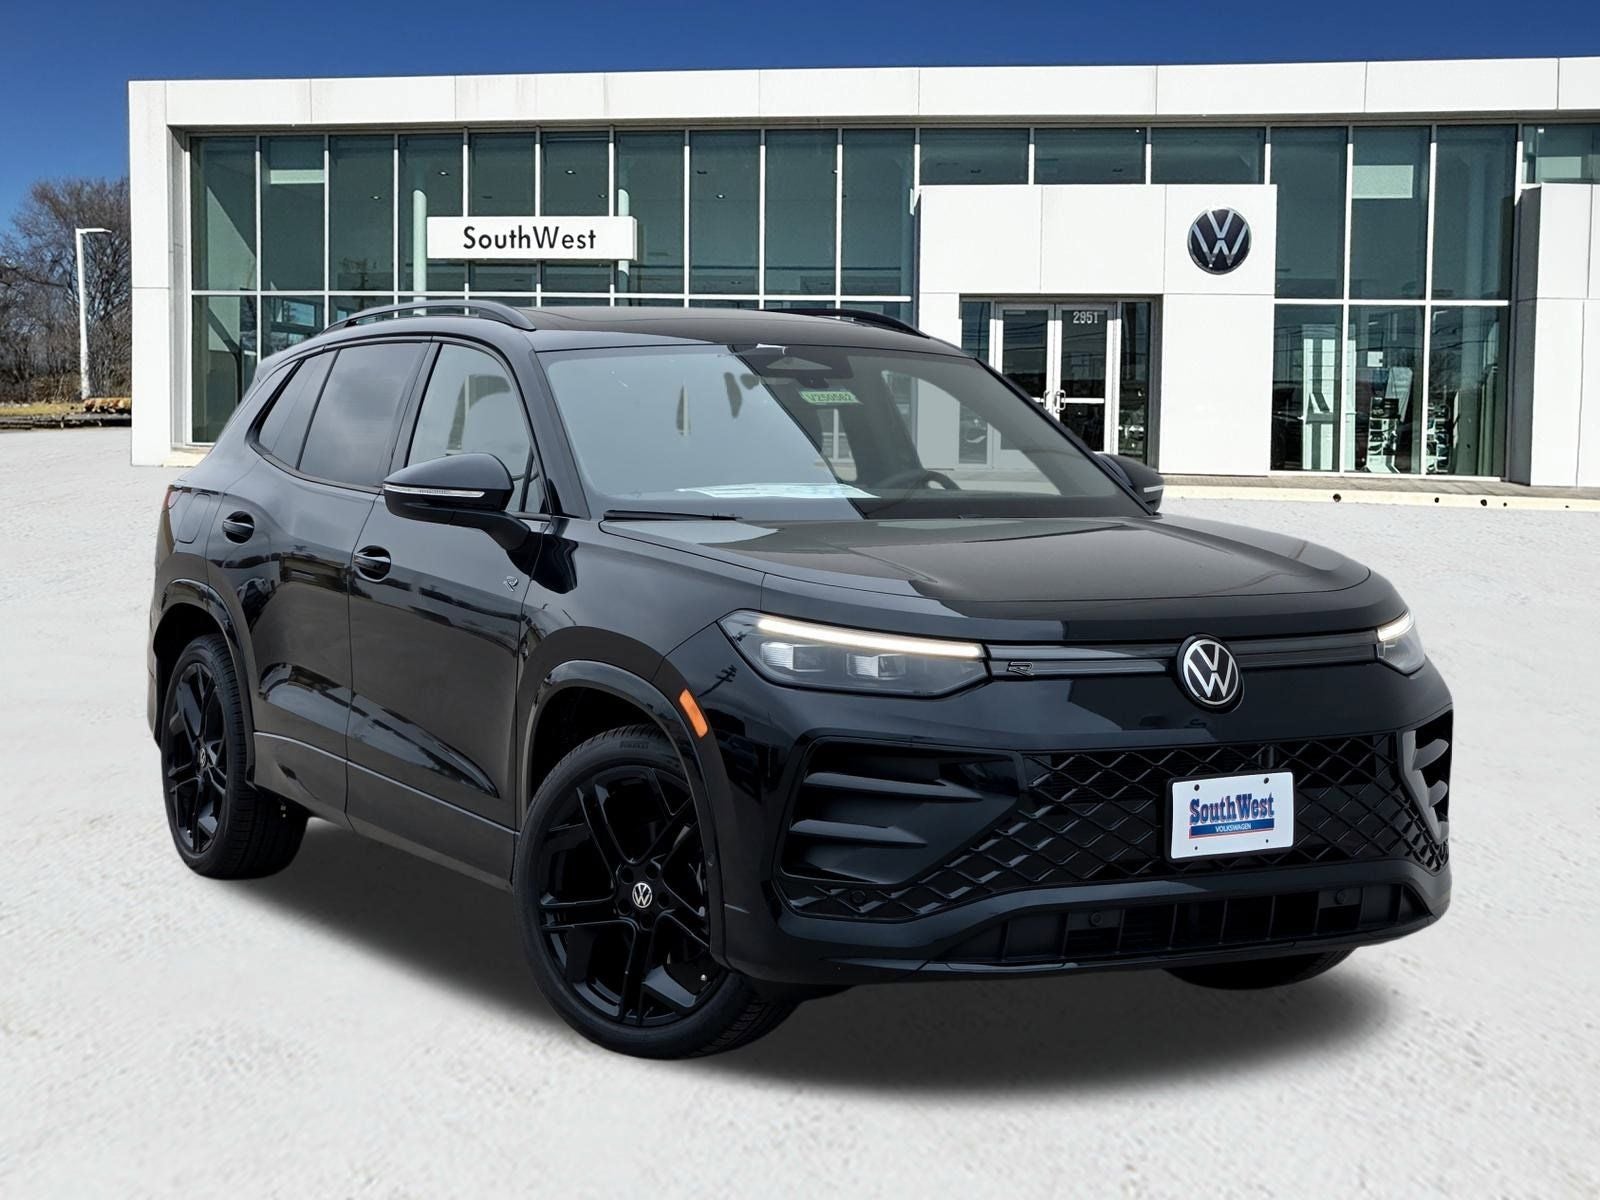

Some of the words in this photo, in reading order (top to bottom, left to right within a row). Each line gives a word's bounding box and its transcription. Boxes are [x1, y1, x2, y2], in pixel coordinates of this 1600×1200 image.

[463, 225, 597, 250] SouthWest
[1189, 208, 1250, 268] VW
[1072, 311, 1098, 324] 2951
[1184, 640, 1239, 705] VW
[1189, 792, 1275, 826] SouthWest
[1215, 823, 1252, 833] VOLKSWAGEN
